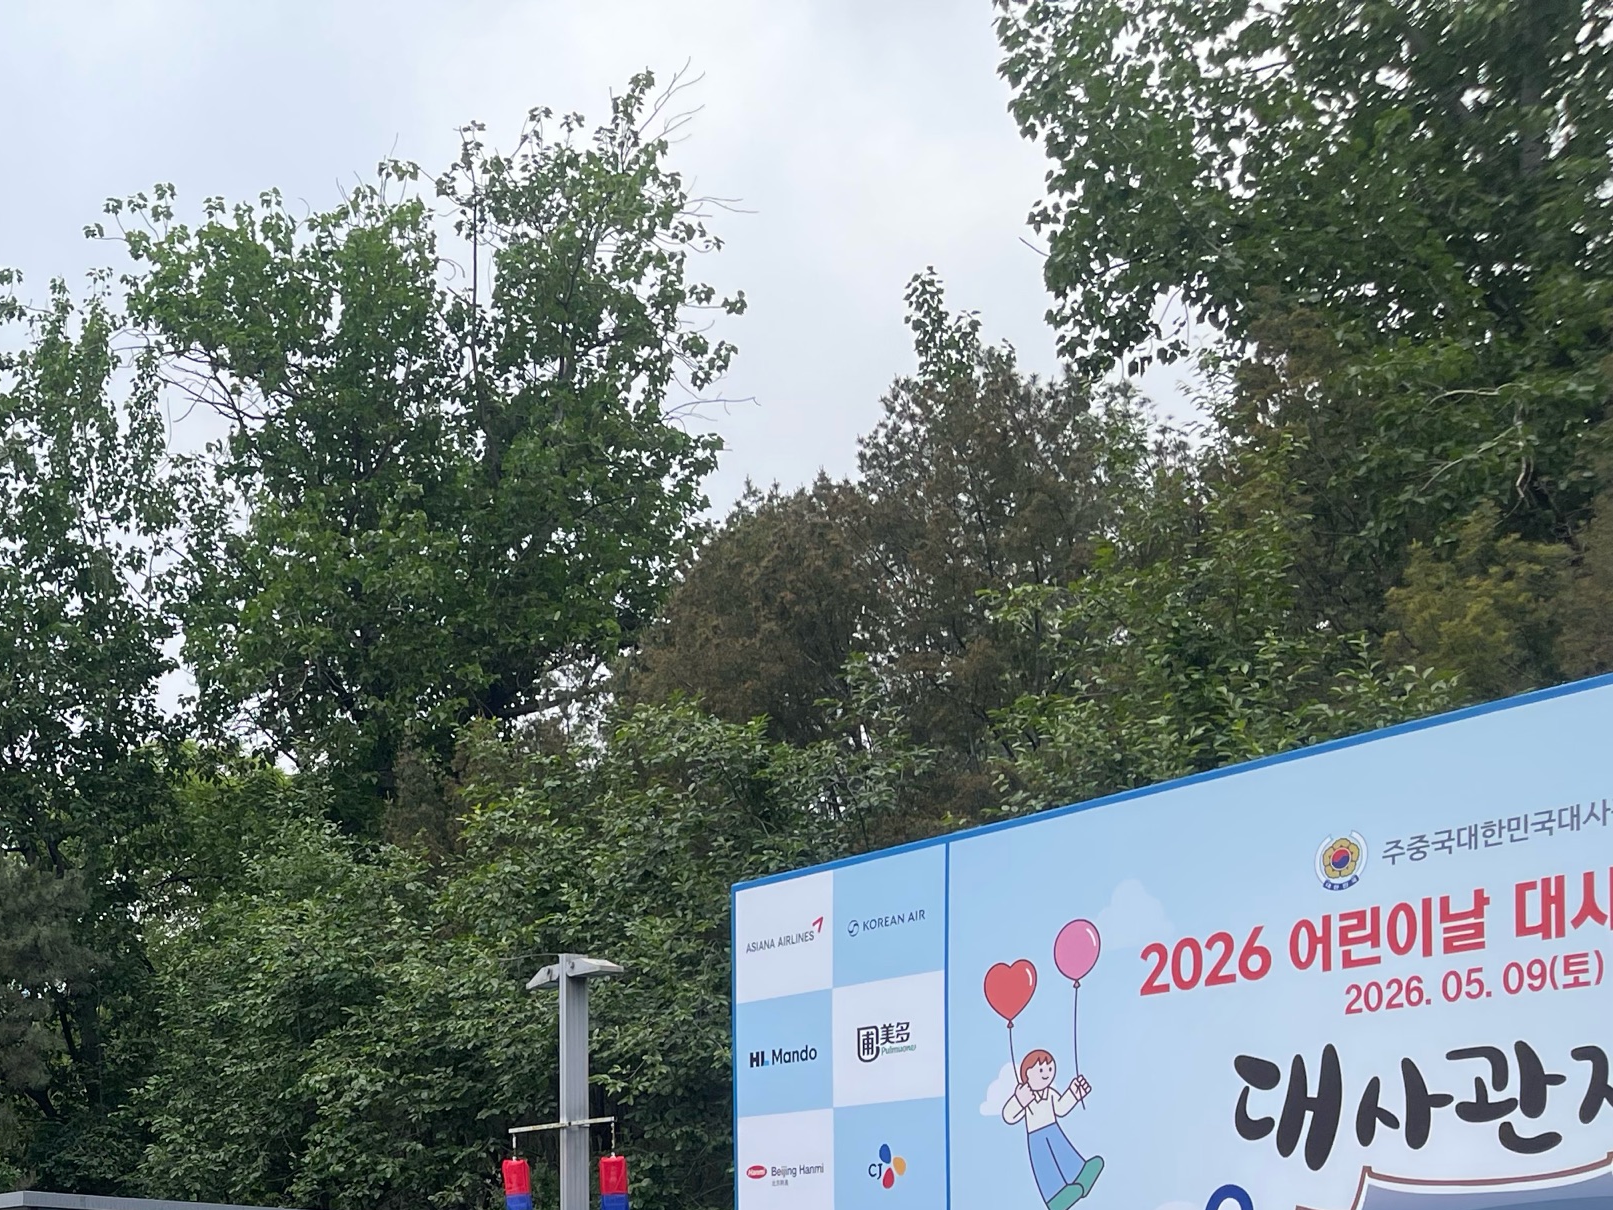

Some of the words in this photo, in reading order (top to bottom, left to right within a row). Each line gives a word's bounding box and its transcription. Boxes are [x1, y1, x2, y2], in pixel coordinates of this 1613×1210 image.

[1382, 799, 1613, 866] 주중국대한민국대사
[862, 913, 905, 932] KOREAN
[907, 909, 926, 922] AIR
[746, 940, 776, 953] ASIANA
[777, 930, 815, 948] AIRLINES
[1140, 924, 1272, 997] 2026
[1288, 888, 1491, 973] 어린이날
[1344, 973, 1431, 1015] 2026.
[1441, 967, 1493, 1003] 05.
[1503, 950, 1604, 995] 09(토)
[771, 1045, 818, 1066] Mando
[771, 1165, 797, 1178] Beijing
[799, 1163, 825, 1176] Hanmi
[868, 1163, 883, 1180] CJ
